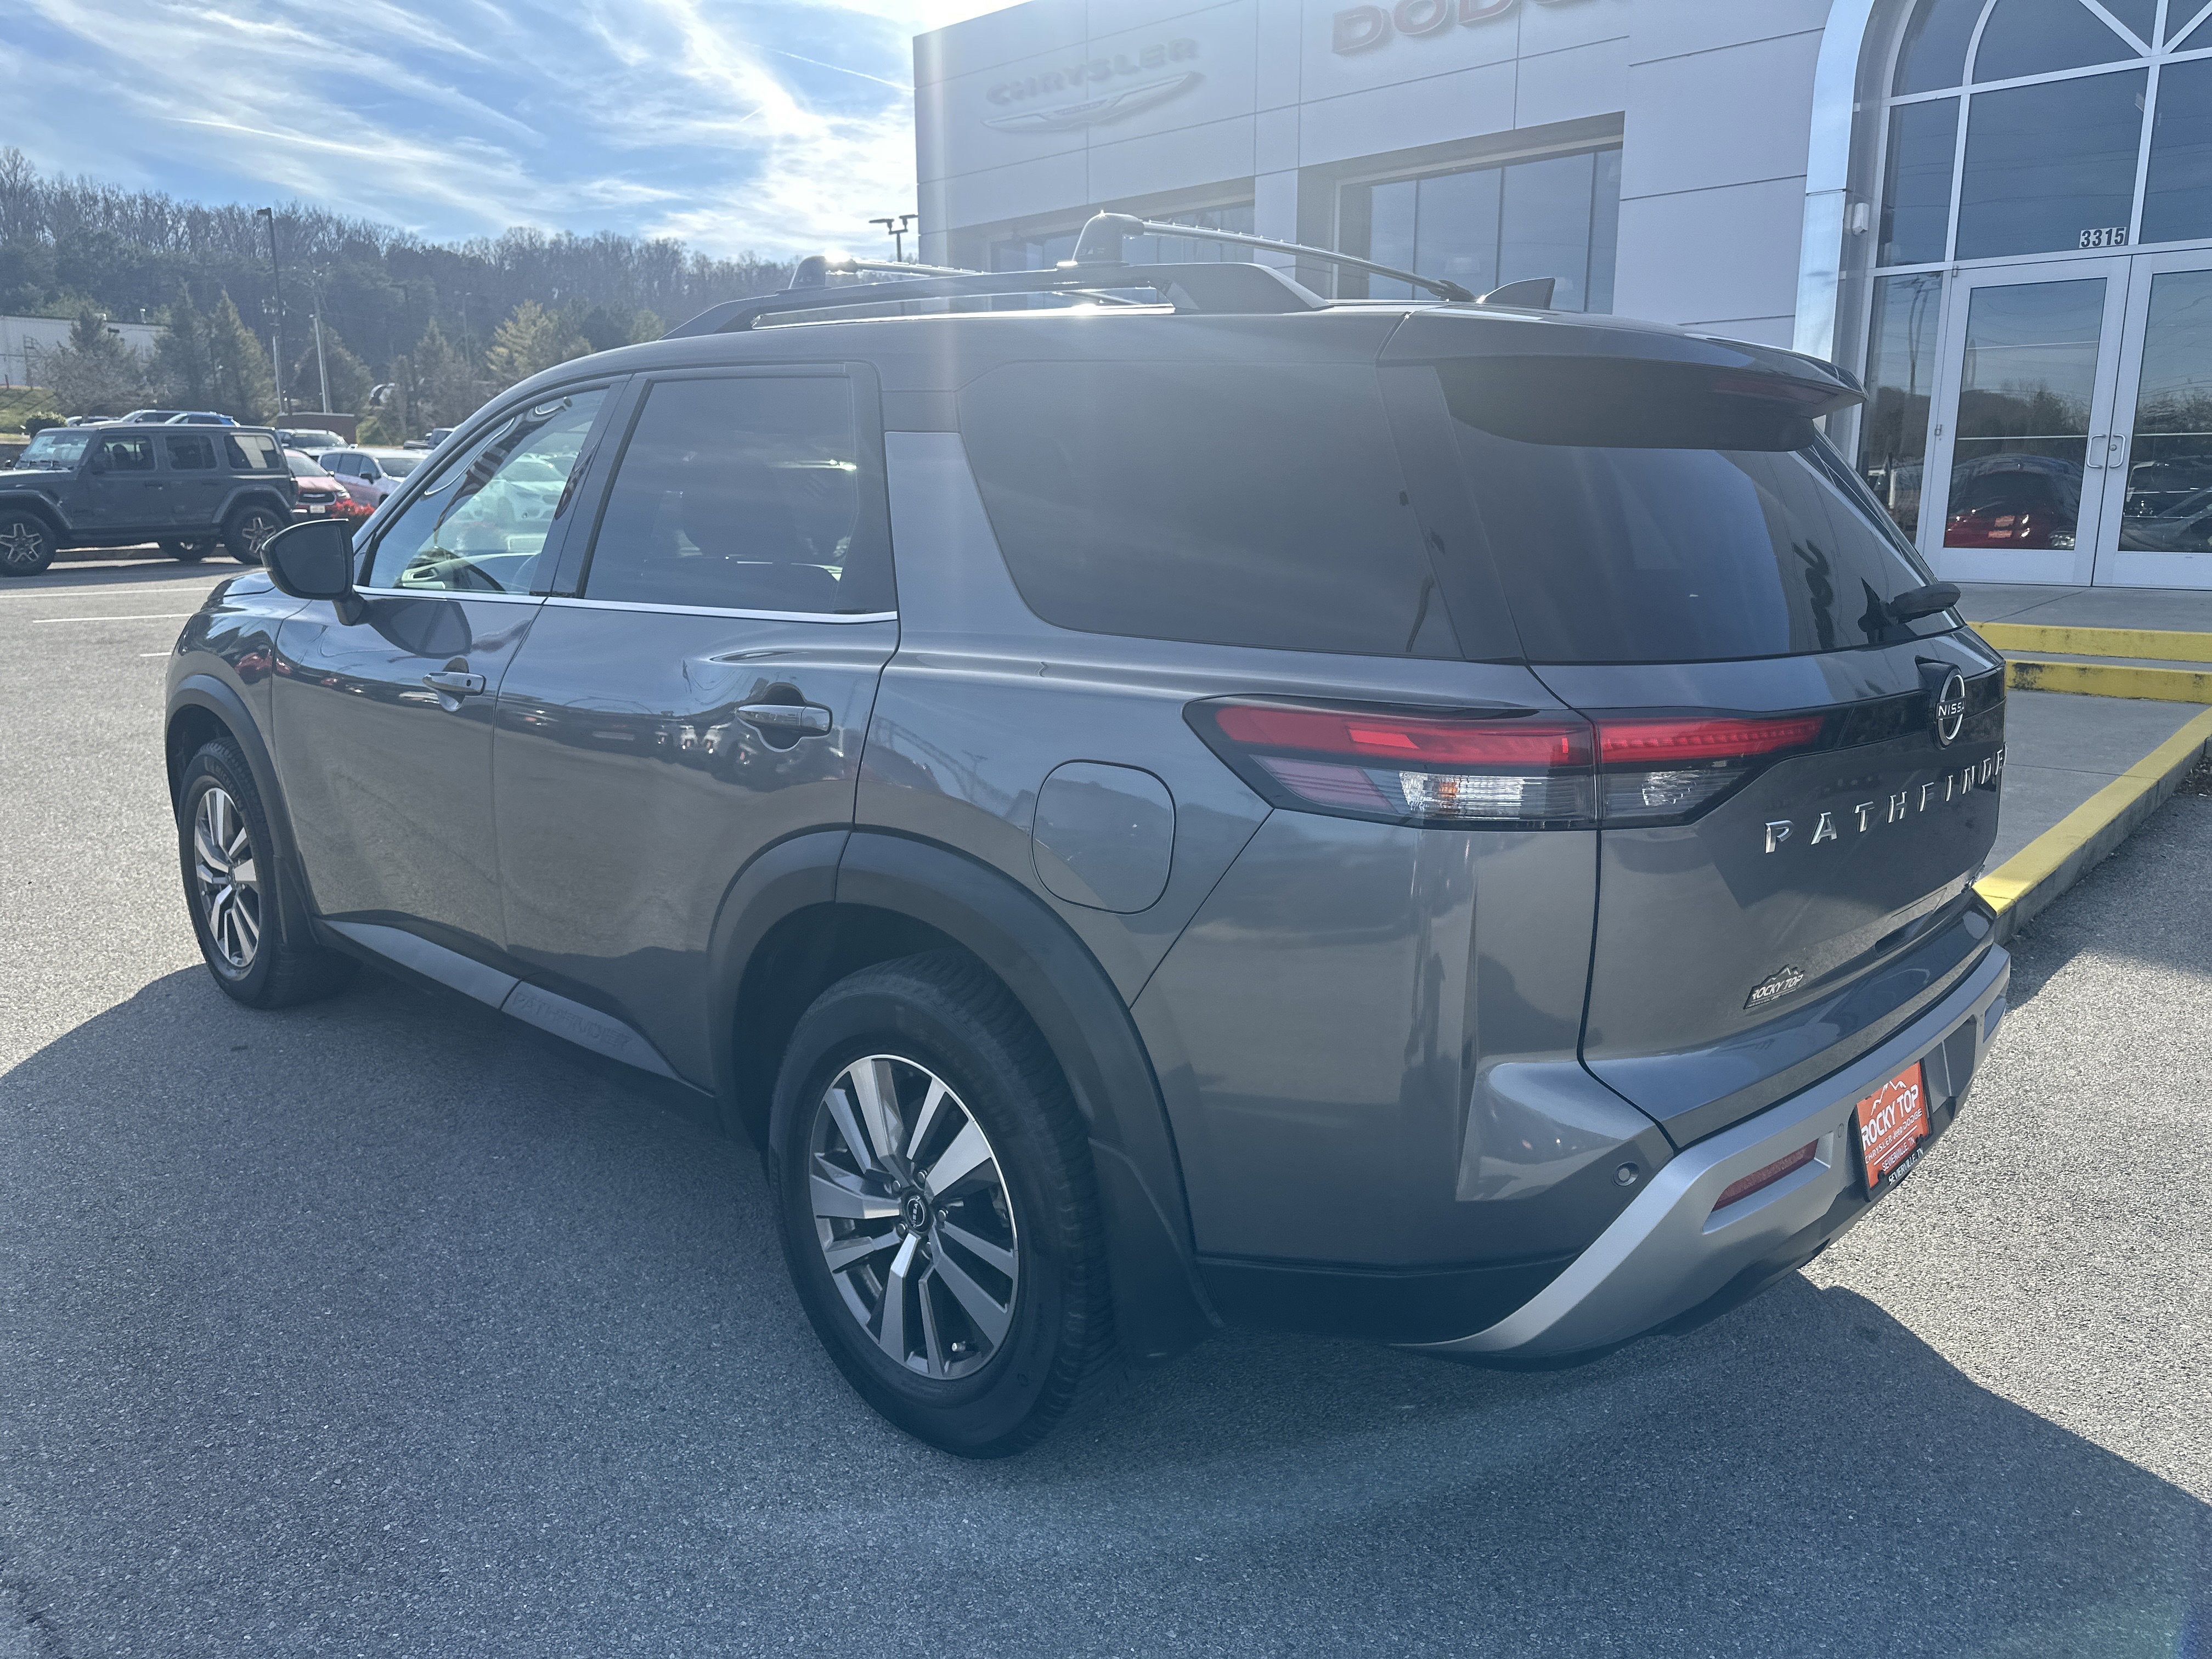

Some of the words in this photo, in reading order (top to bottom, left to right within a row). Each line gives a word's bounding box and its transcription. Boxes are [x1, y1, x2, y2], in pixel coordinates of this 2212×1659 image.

[986, 37, 1200, 105] CHRYSLER
[2080, 228, 2125, 248] 3315
[1938, 702, 1965, 716] NISS
[1764, 742, 2007, 853] PATHFINDE
[1752, 980, 1785, 1000] ROCKY
[1783, 974, 1804, 990] TOP
[1861, 1100, 1896, 1152] ROCKY
[1897, 1084, 1918, 1119] TOP
[1865, 1135, 1893, 1164] CHRYSLER
[1893, 1126, 1903, 1140] Jeep
[1902, 1108, 1922, 1131] DODGE
[1908, 1136, 1915, 1146] TN
[1917, 1147, 1924, 1159] TN
